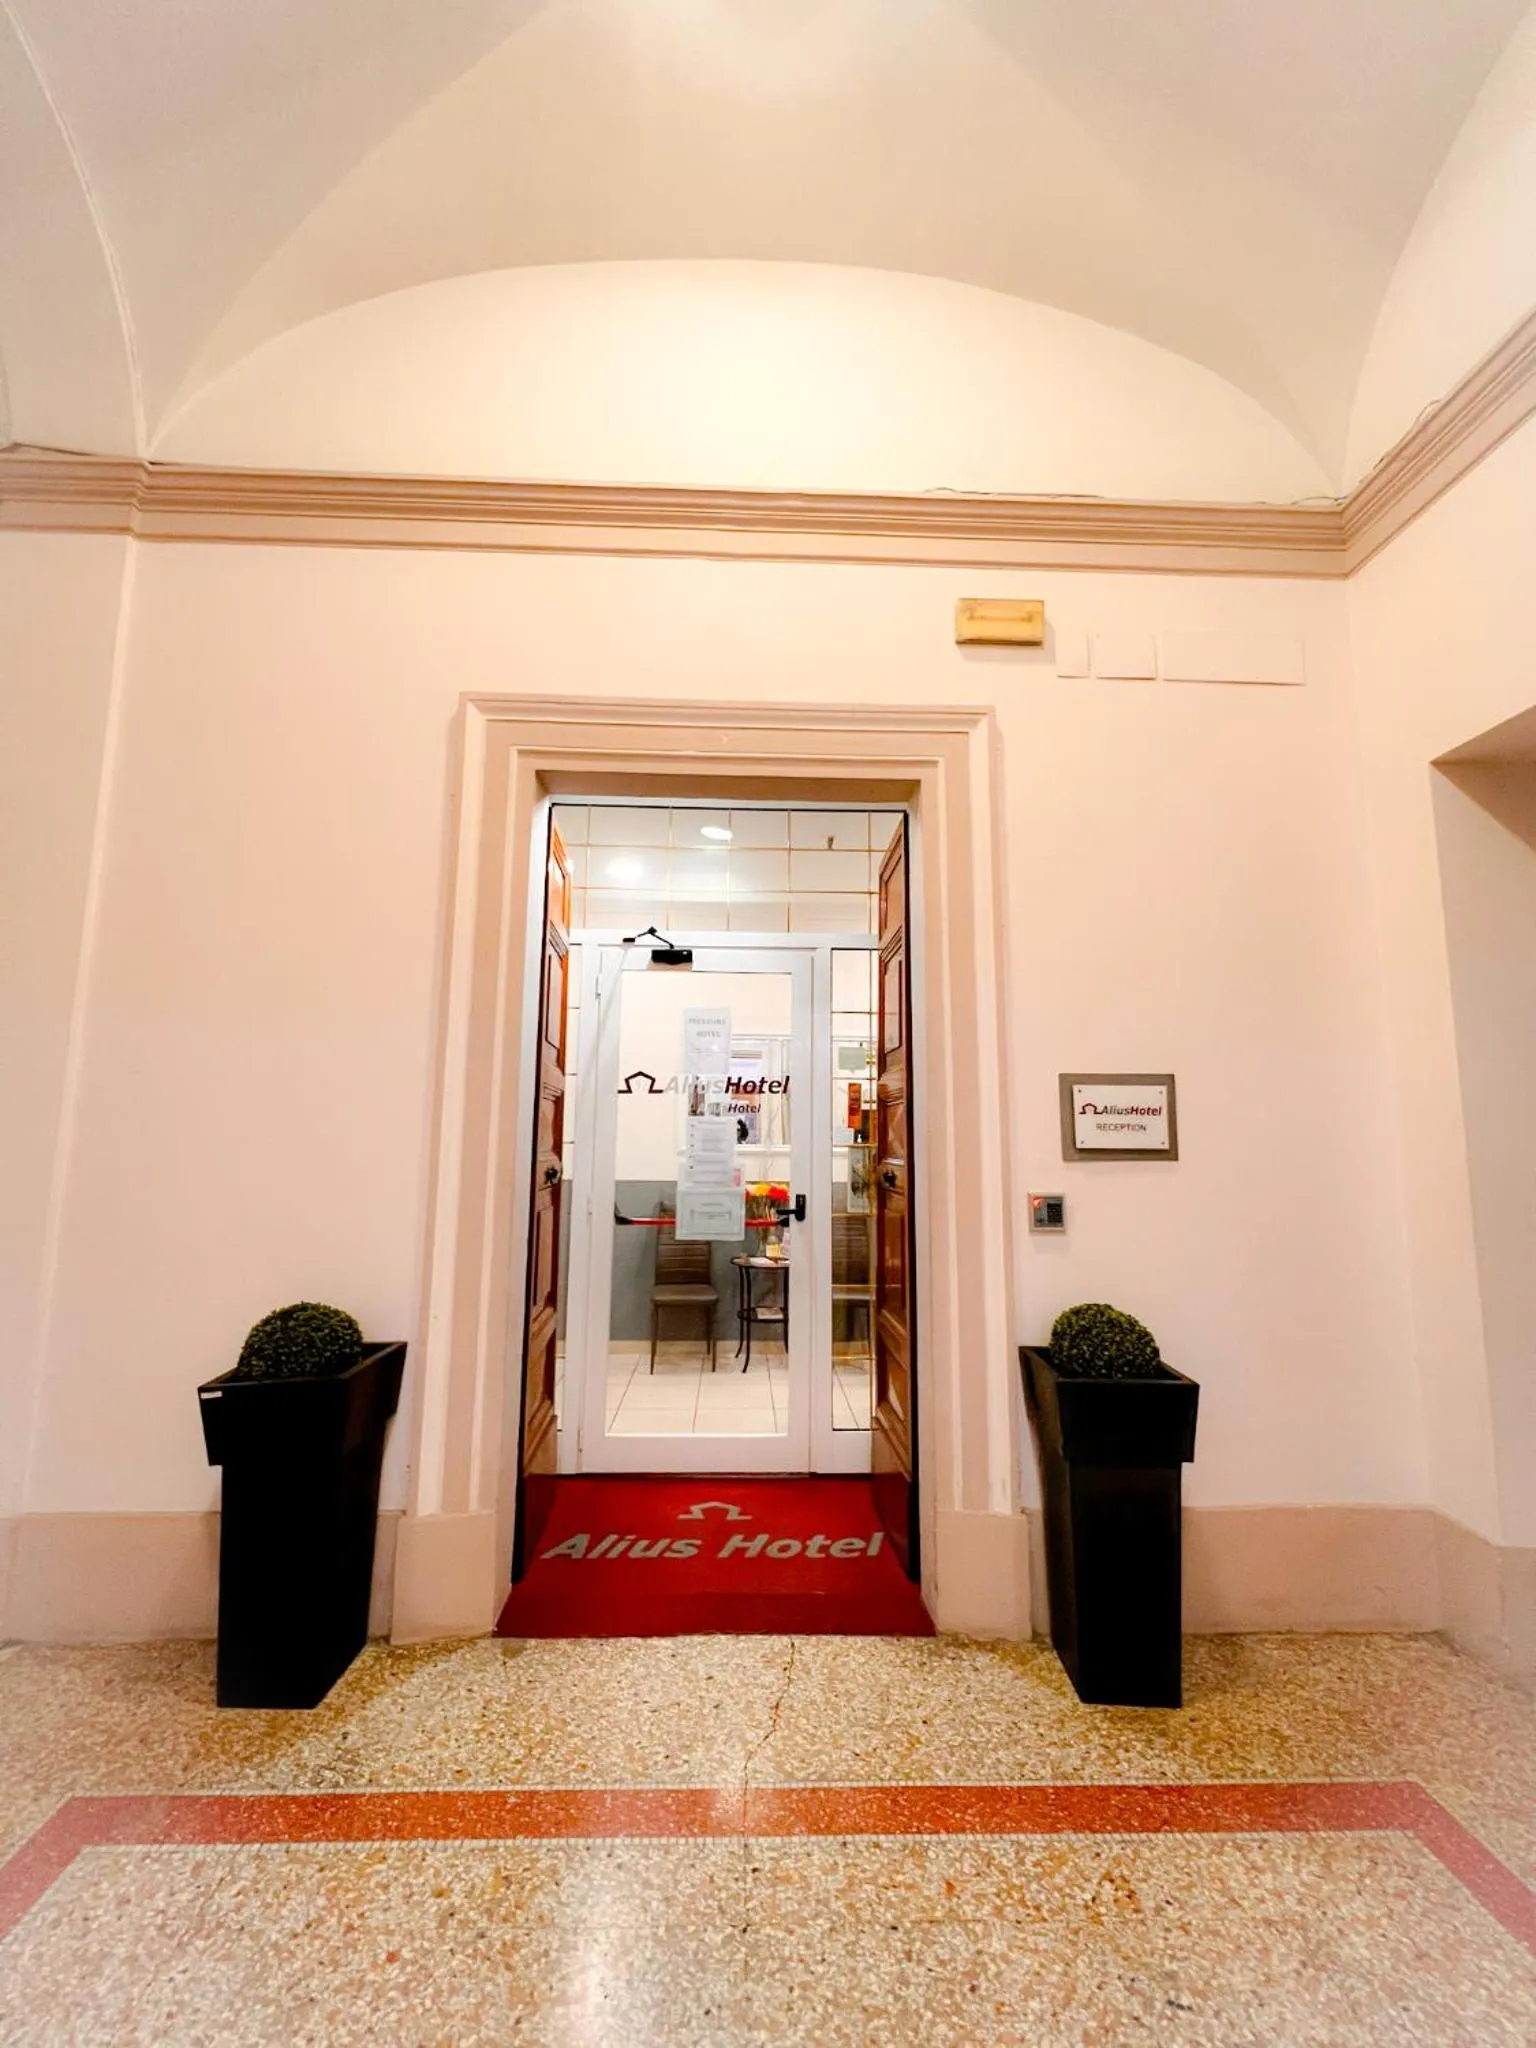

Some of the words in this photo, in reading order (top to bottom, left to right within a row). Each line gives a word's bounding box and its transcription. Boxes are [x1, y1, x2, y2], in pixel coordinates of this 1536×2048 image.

[1096, 1123, 1147, 1132] RECEPTION
[540, 1533, 703, 1560] Alius
[717, 1532, 884, 1560] Hotel
